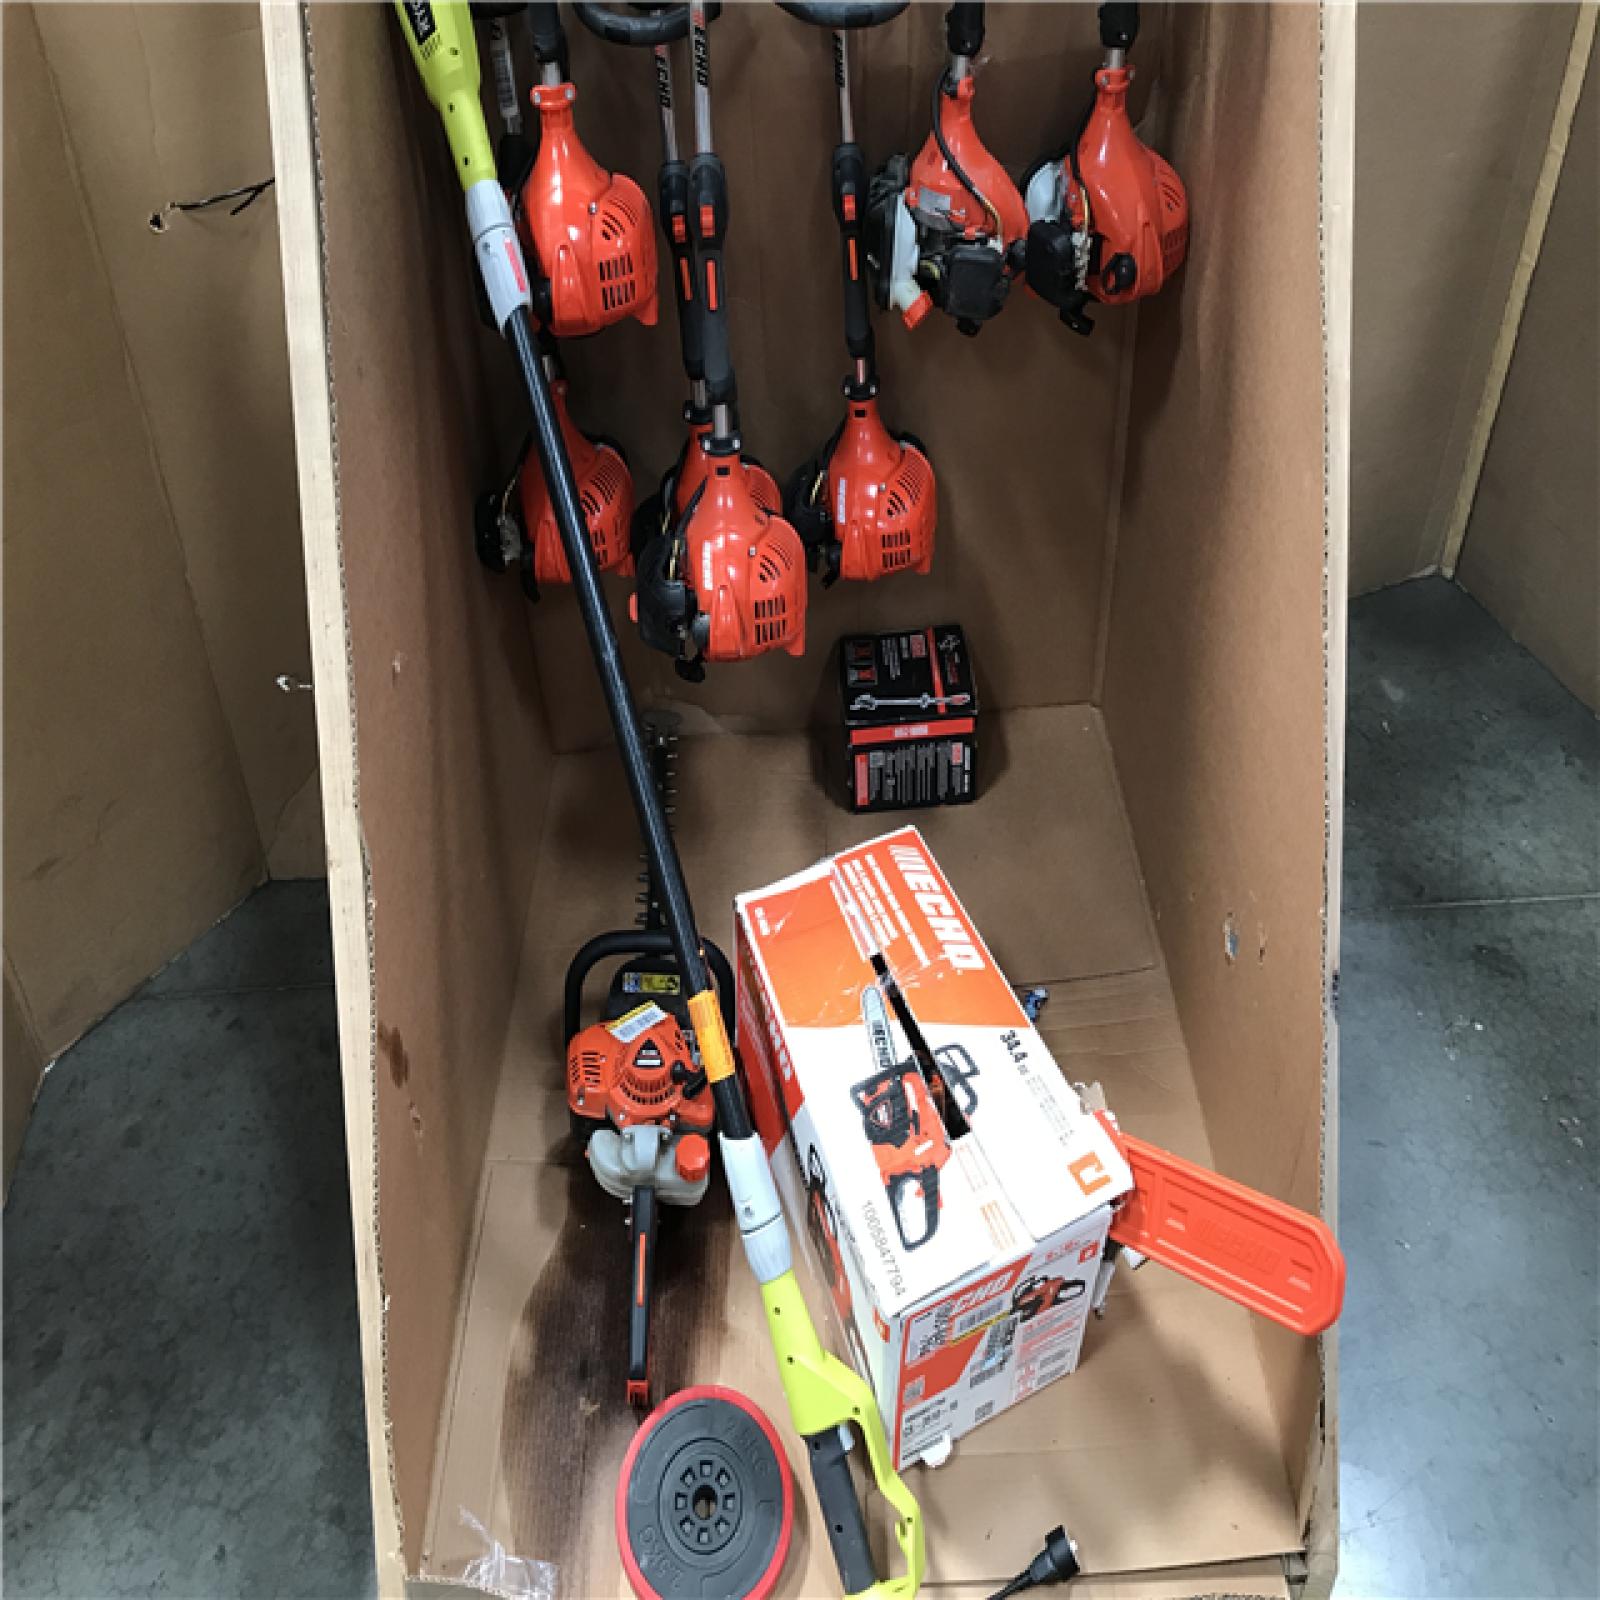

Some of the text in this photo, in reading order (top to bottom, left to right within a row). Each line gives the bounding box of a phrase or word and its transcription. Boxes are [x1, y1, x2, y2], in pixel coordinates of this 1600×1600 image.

[655, 54, 671, 108] ECHO
[694, 26, 708, 87] ECHO
[900, 869, 986, 970] ECHO
